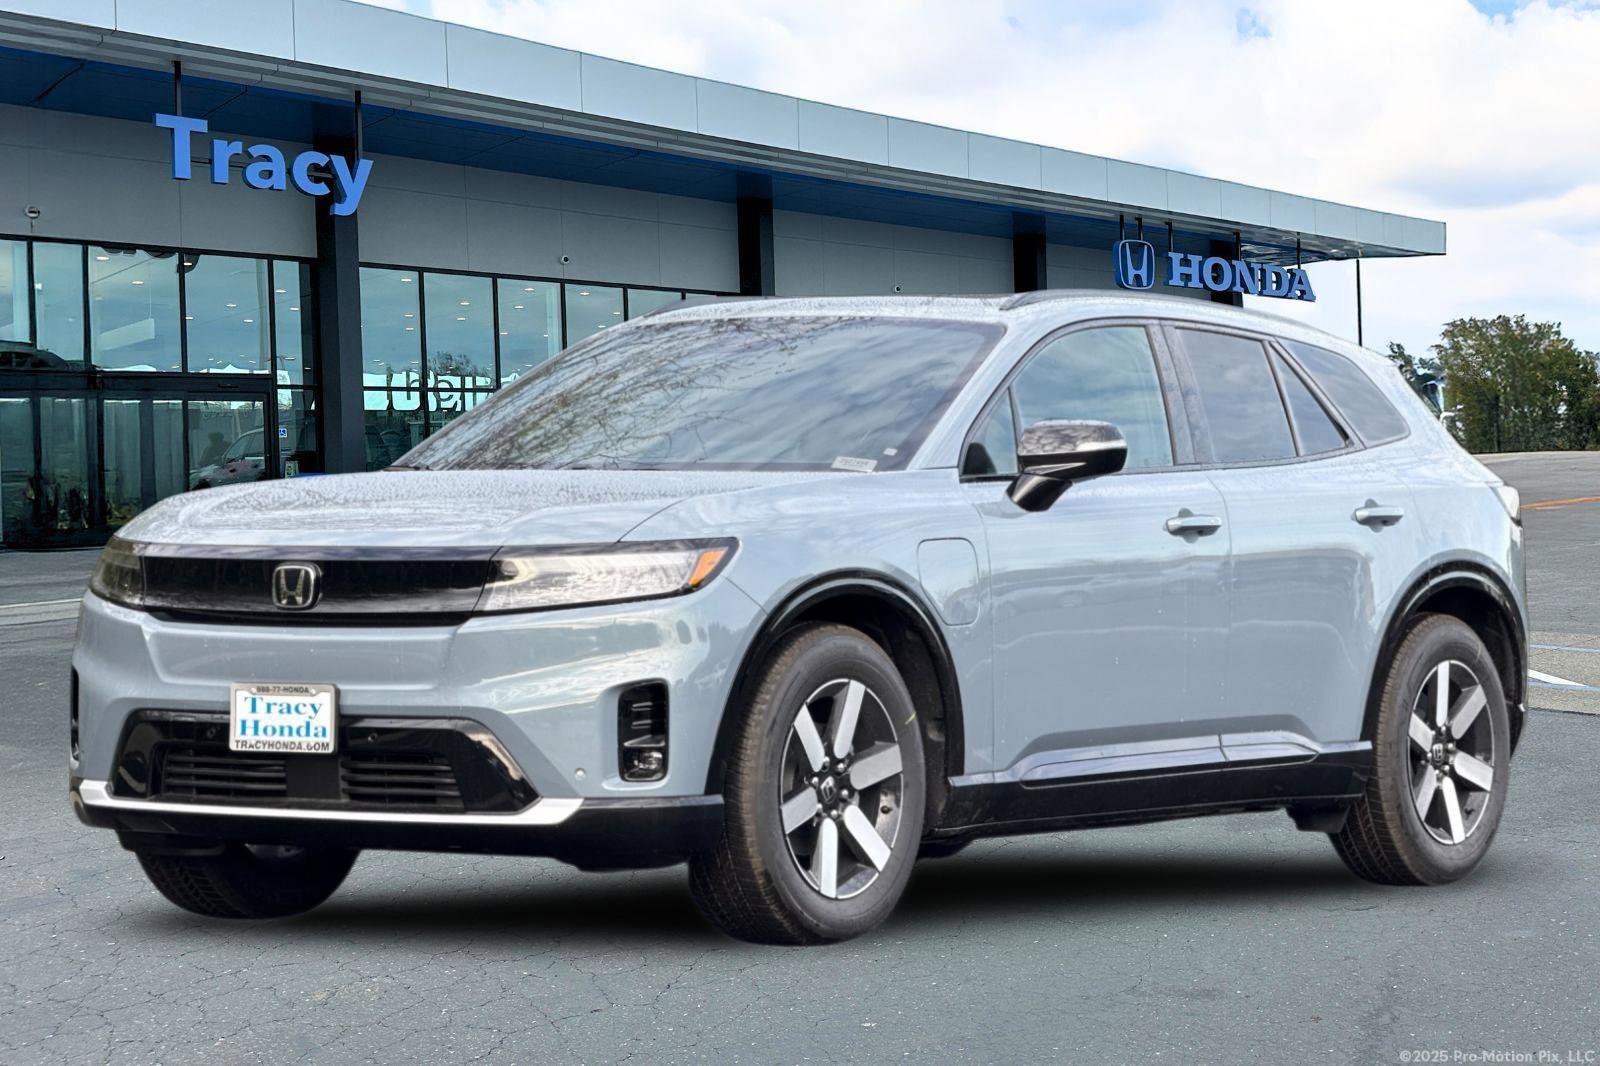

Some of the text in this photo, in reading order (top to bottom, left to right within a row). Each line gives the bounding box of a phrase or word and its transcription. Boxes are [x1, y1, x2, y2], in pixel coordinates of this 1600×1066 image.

[154, 113, 374, 216] Tracy
[1166, 251, 1317, 301] HONDA
[244, 696, 323, 720] Tracy
[240, 719, 327, 738] Honda
